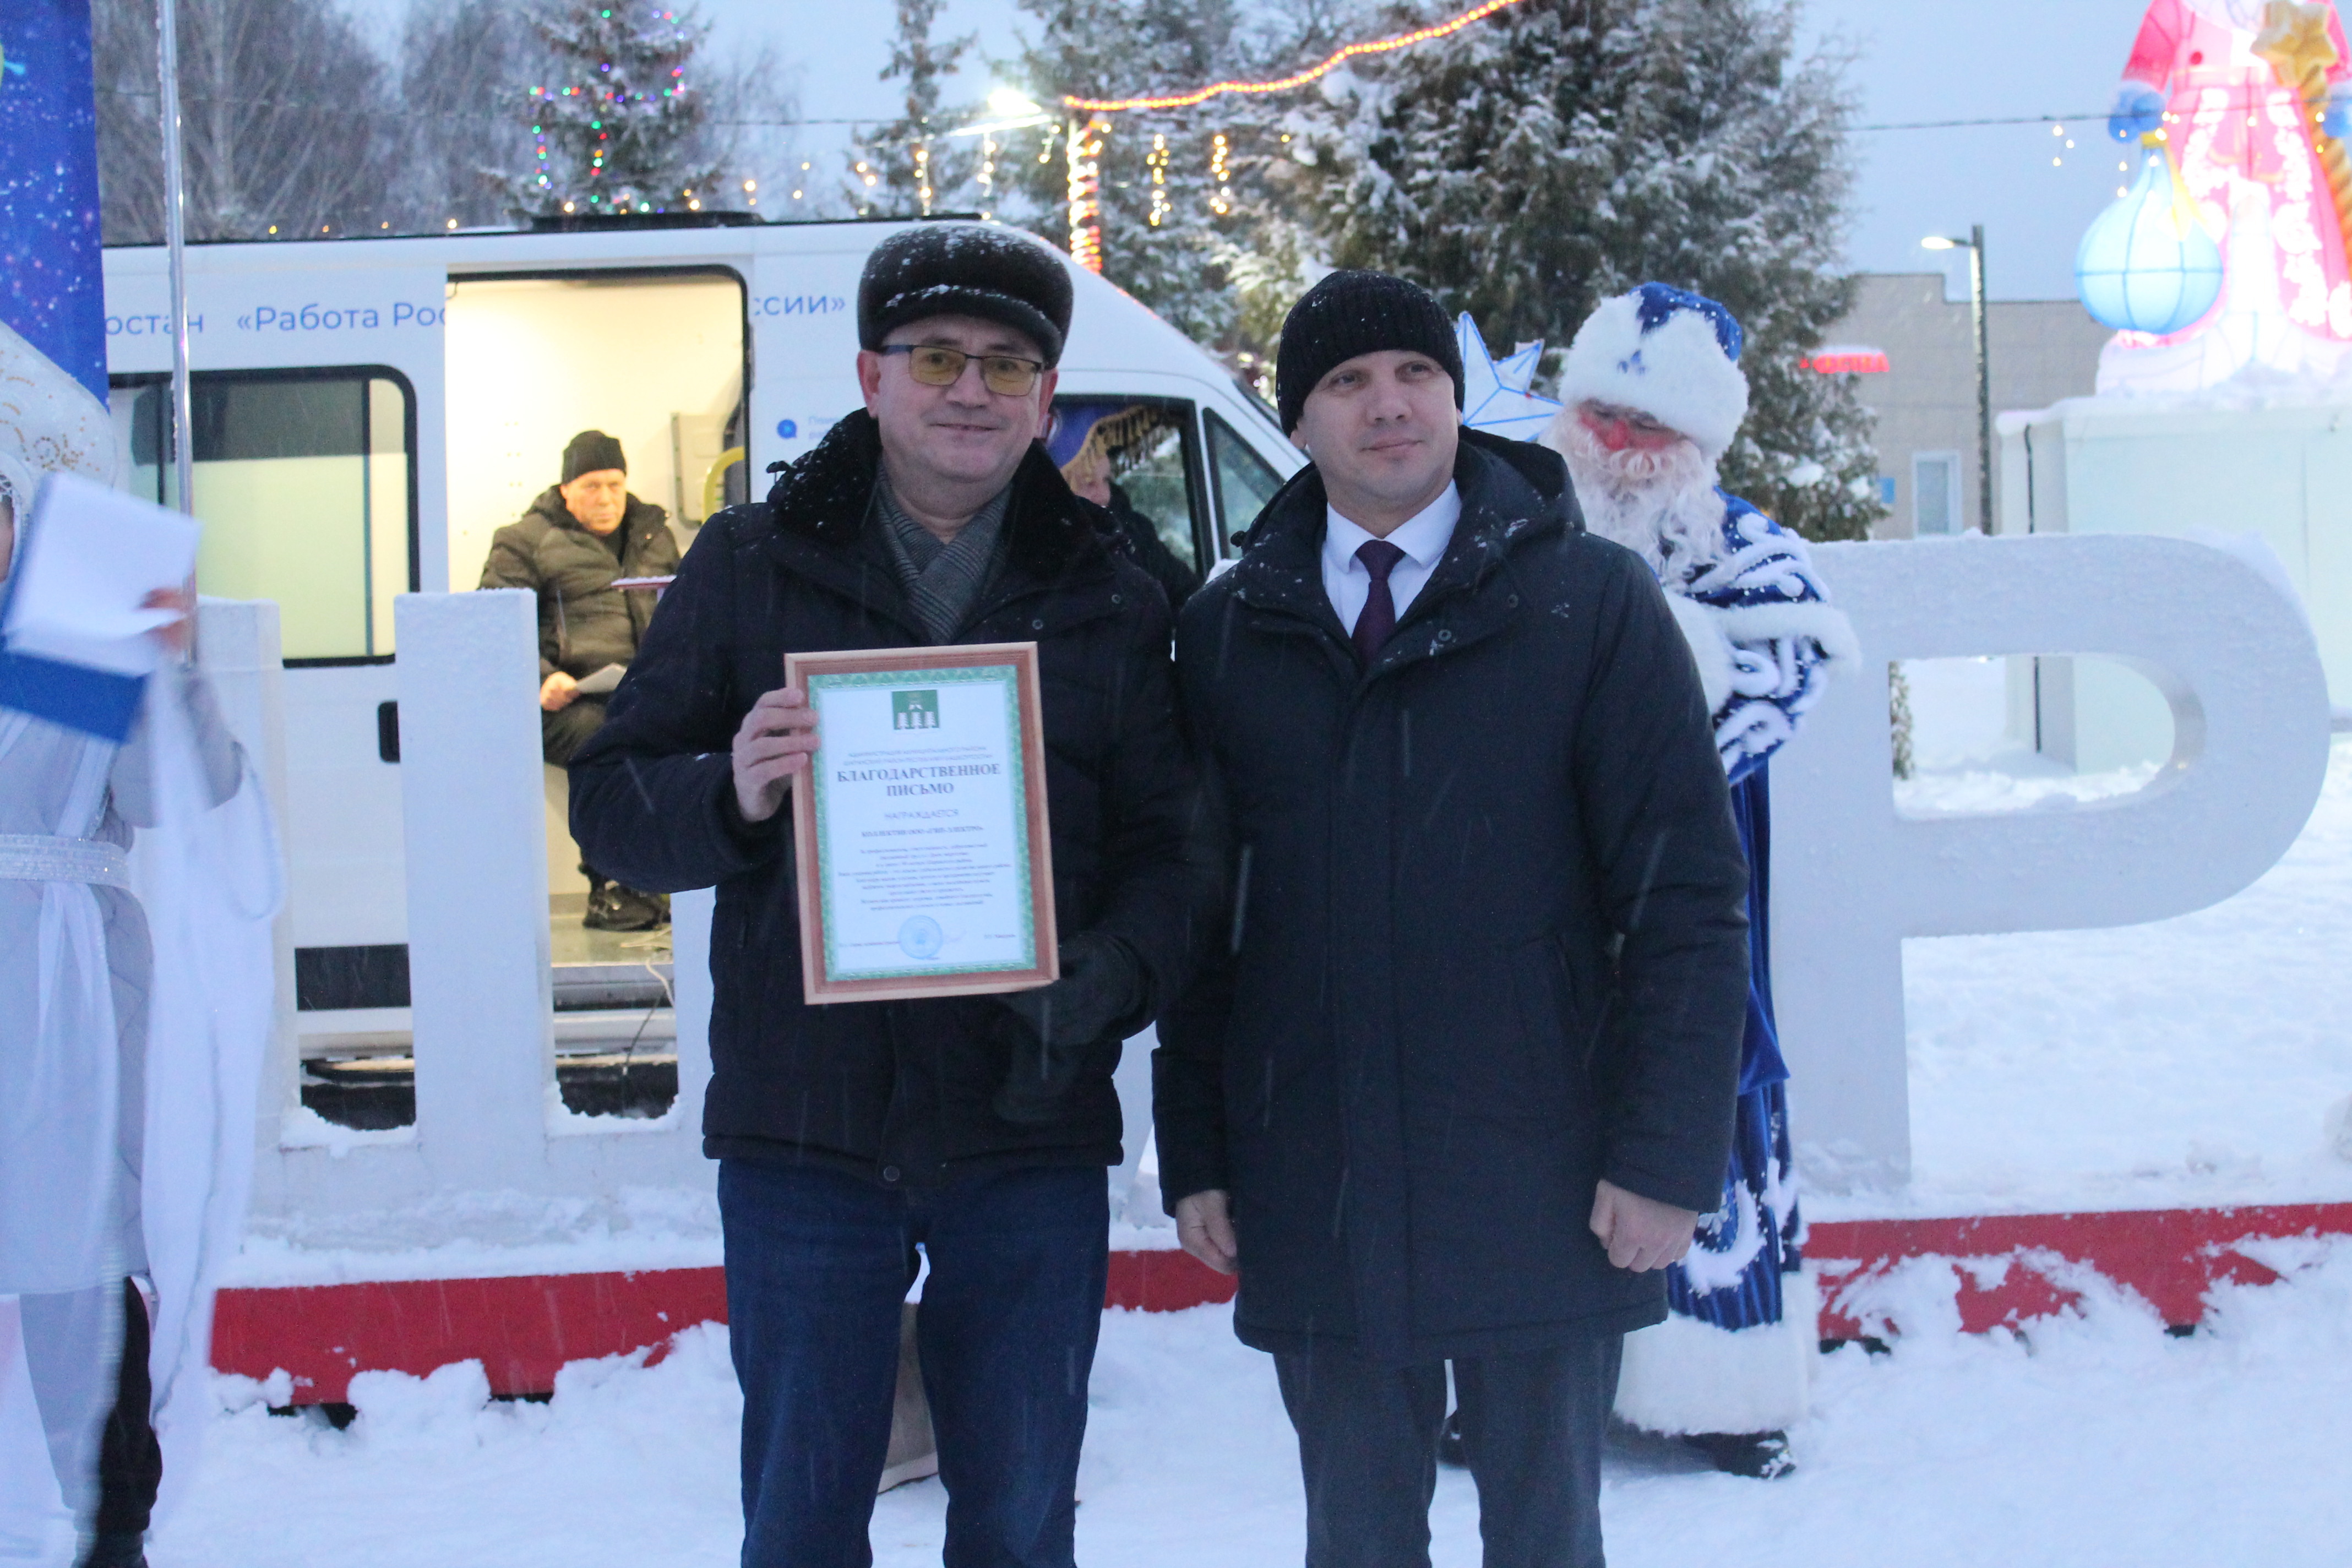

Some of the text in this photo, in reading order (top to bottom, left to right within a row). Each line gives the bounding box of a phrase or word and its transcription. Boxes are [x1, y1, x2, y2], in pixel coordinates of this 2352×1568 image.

[237, 303, 378, 331] «Работа
[837, 764, 1000, 782] БЛАГОДАРСТВЕННОЕ
[886, 782, 955, 796] ПИСЬМО
[884, 809, 959, 819] НАГРАЖДАЕТСЯ
